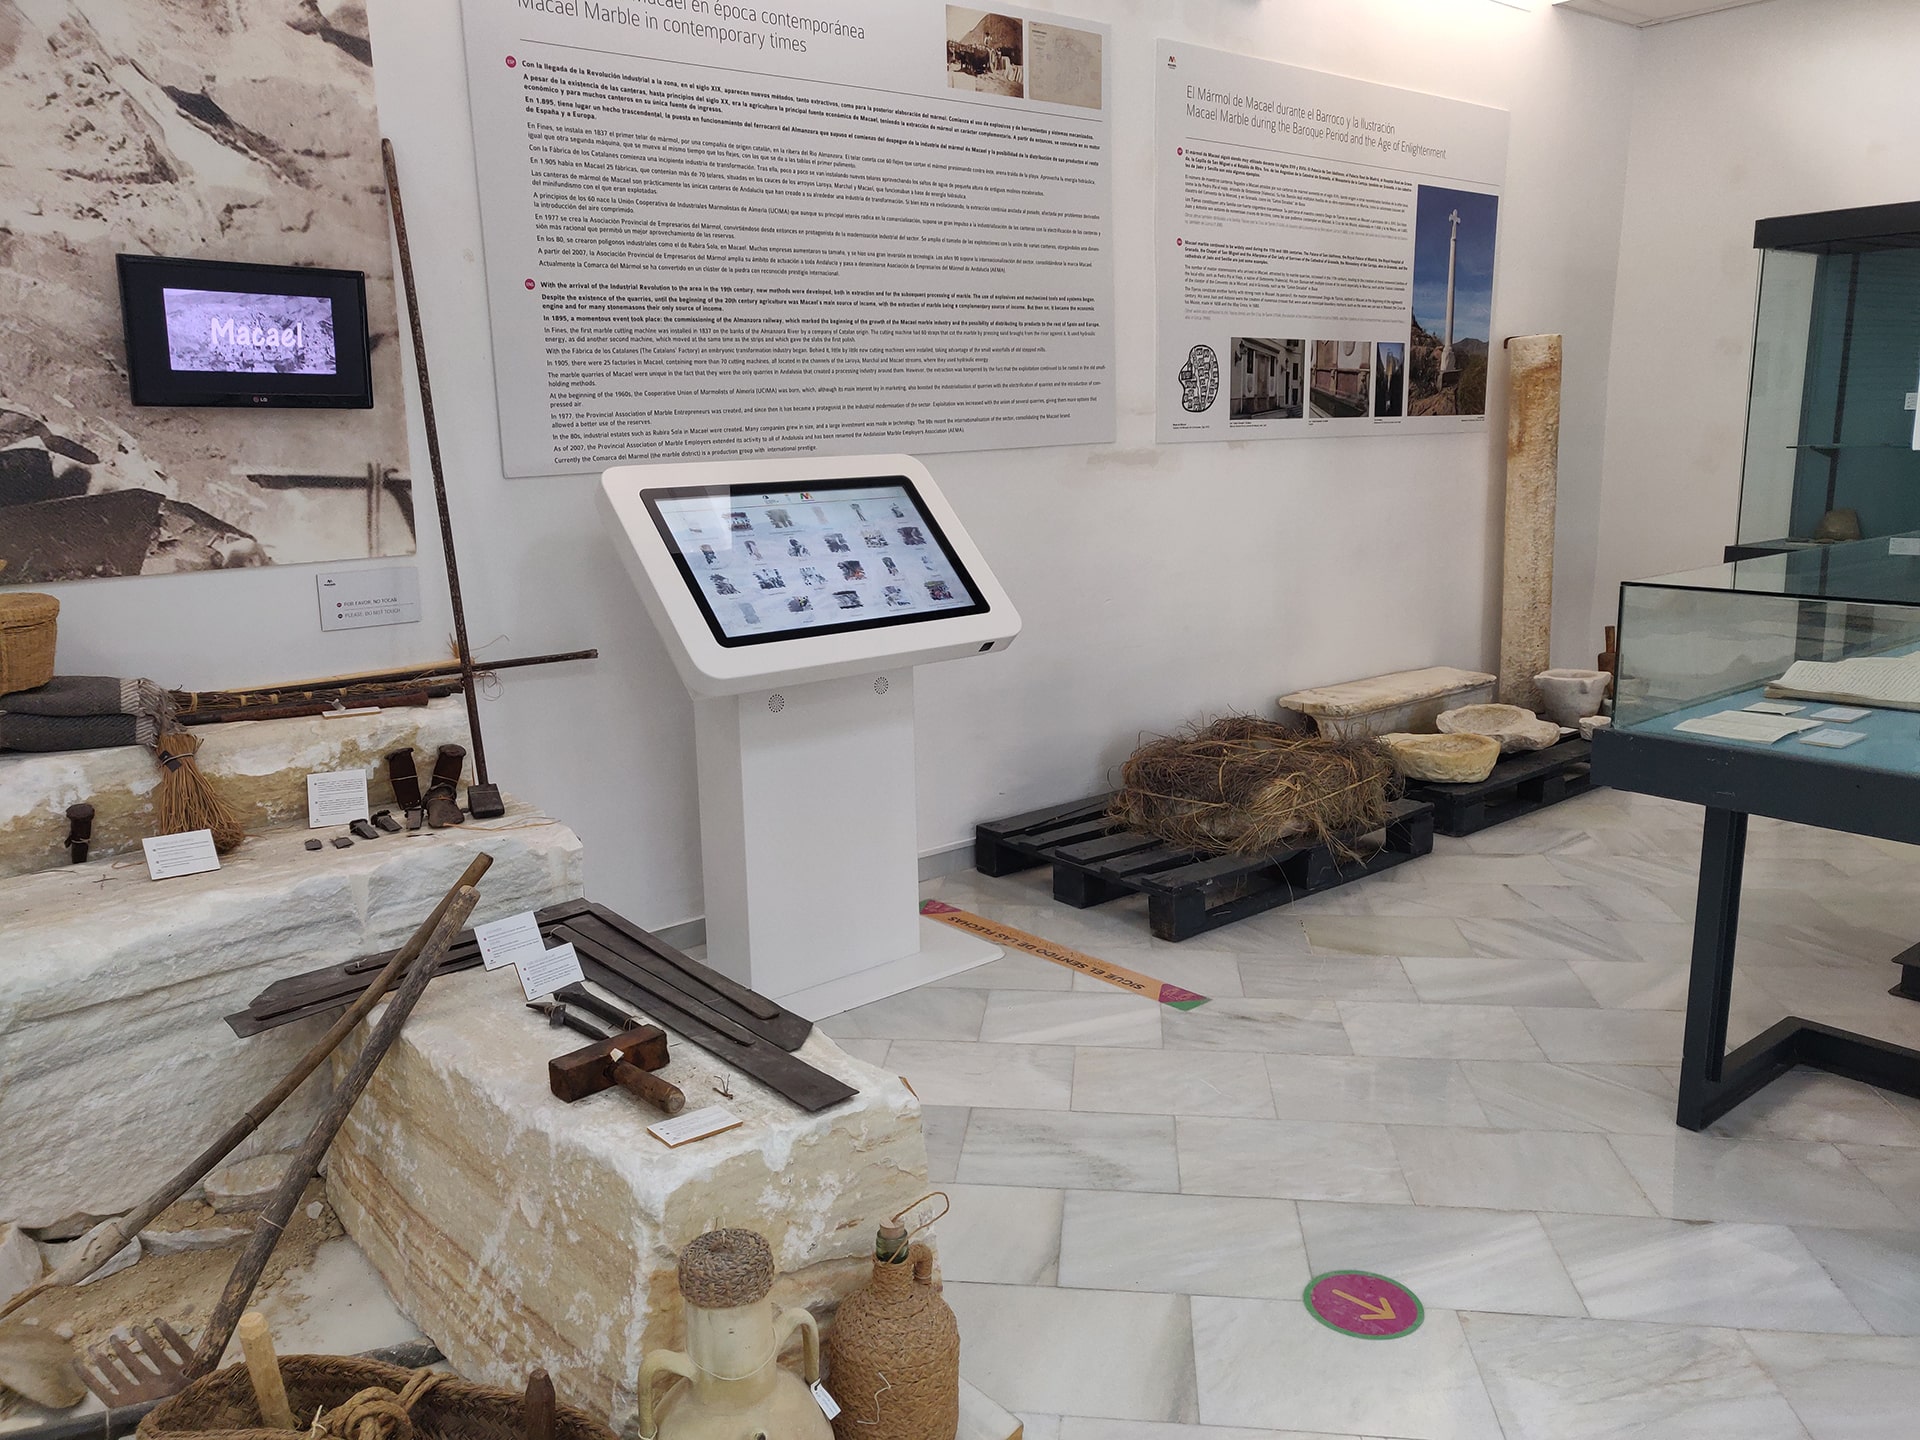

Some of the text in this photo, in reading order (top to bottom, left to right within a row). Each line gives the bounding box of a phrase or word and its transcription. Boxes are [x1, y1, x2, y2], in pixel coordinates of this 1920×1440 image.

[584, 1, 639, 26] Marble
[645, 11, 658, 29] in
[663, 18, 765, 50] contemporary
[769, 32, 806, 52] times
[690, 0, 709, 14] en
[714, 0, 756, 21] época
[761, 11, 864, 39] contemporánea
[1186, 85, 1395, 134] El Mármol de Macael durante el Barroco y la Ilustración
[1186, 103, 1446, 159] Macael Marble during the Baroque Period and the Age of Enlightenment
[211, 317, 303, 348] Macael
[948, 916, 1146, 990] SIGUE EL SENTIDO DE LAS FLECHAS
